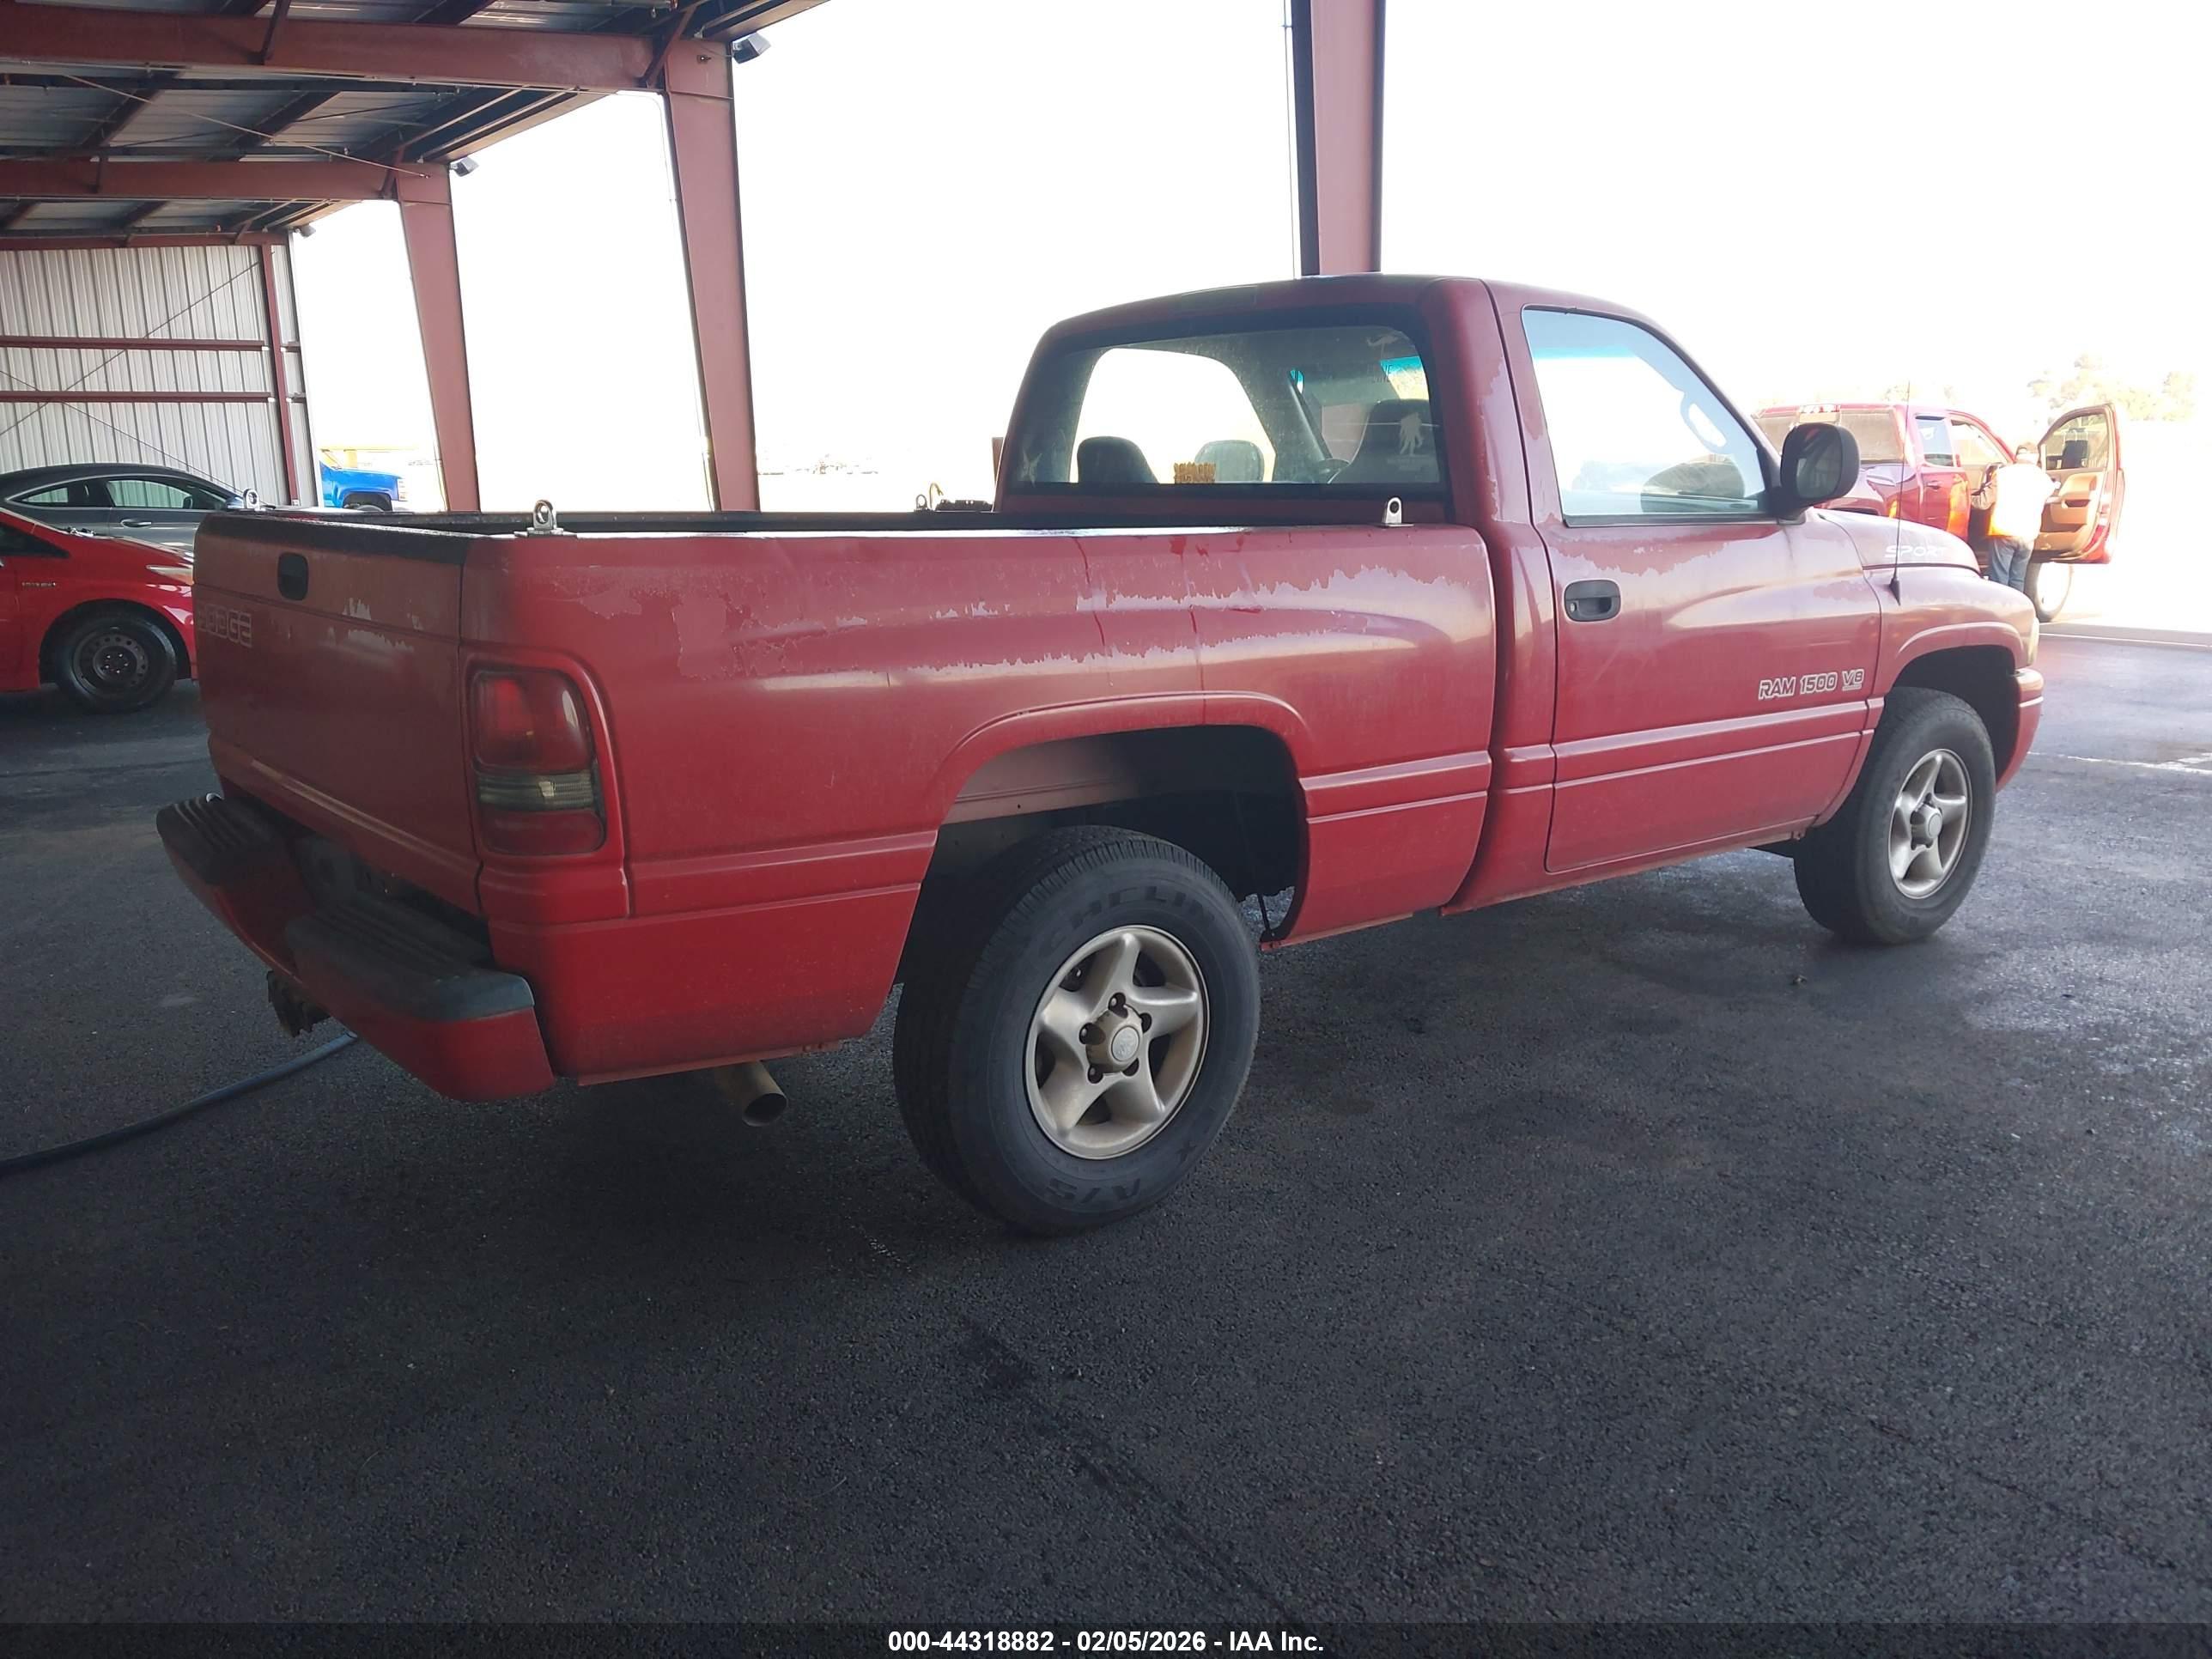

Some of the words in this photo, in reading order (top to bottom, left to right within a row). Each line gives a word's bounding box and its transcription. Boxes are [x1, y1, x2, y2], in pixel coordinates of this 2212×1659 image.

[1883, 544, 1948, 558] SPORT
[1758, 677, 1796, 700] RAM
[1800, 672, 1838, 695] 1500
[1841, 669, 1864, 687] V8
